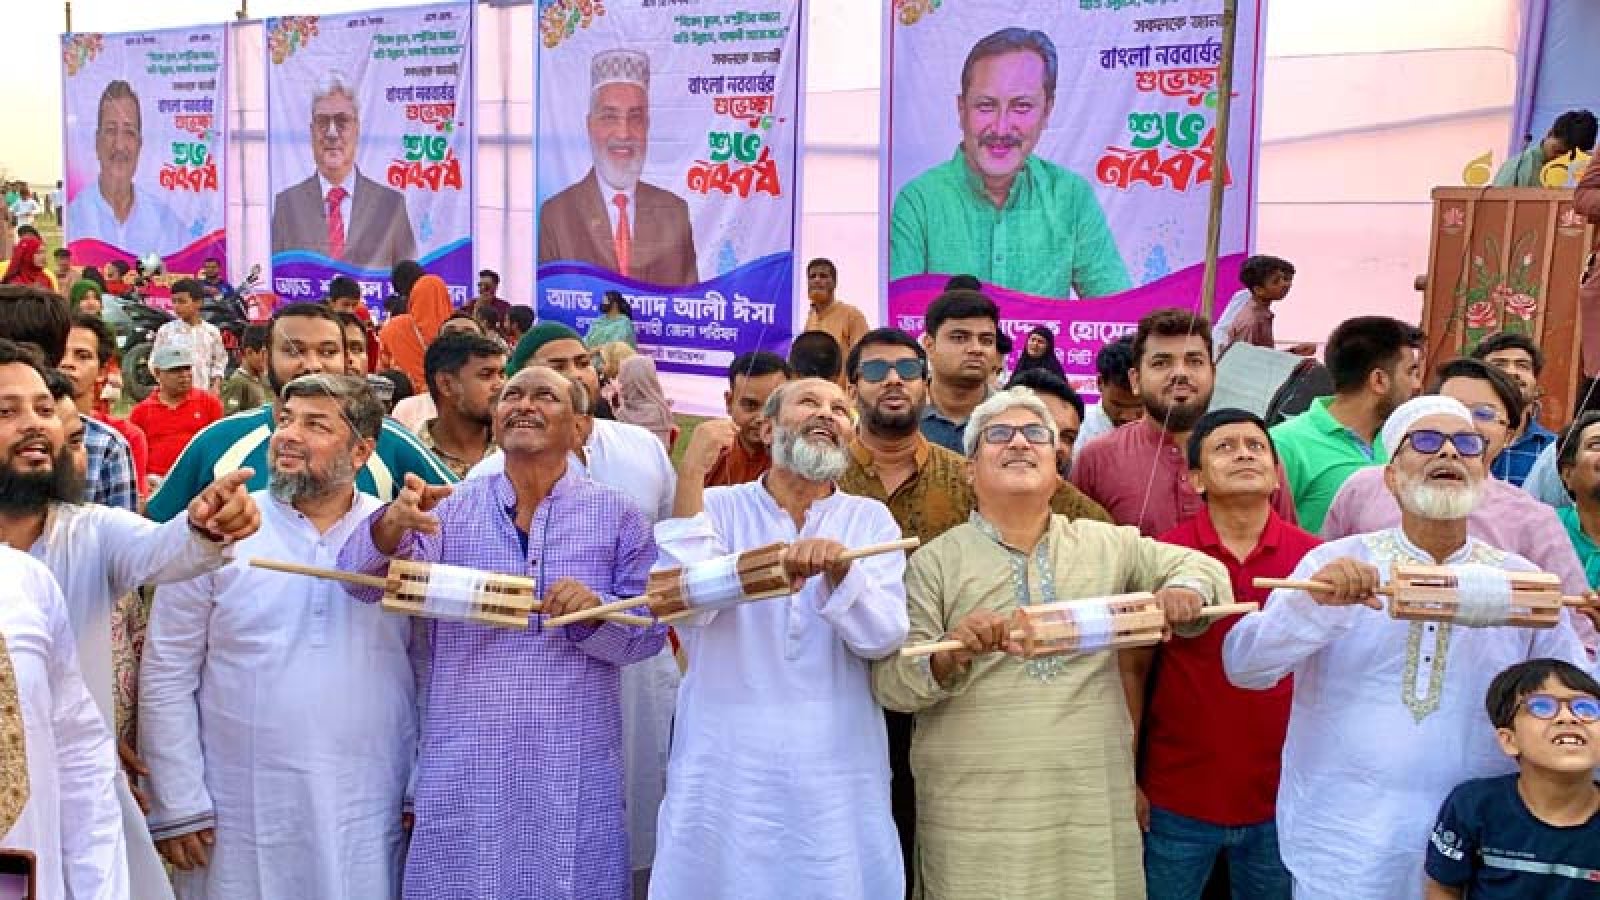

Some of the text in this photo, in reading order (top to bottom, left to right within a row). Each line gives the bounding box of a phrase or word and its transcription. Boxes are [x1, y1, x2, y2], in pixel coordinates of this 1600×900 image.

[1099, 44, 1152, 69] বাংলা
[688, 76, 725, 94] বাংলা
[1128, 111, 1205, 148] শুভ
[403, 134, 449, 161] শুভ
[708, 131, 761, 163] শুভ
[686, 146, 782, 198] নববর্ষ
[672, 291, 727, 321] আলী
